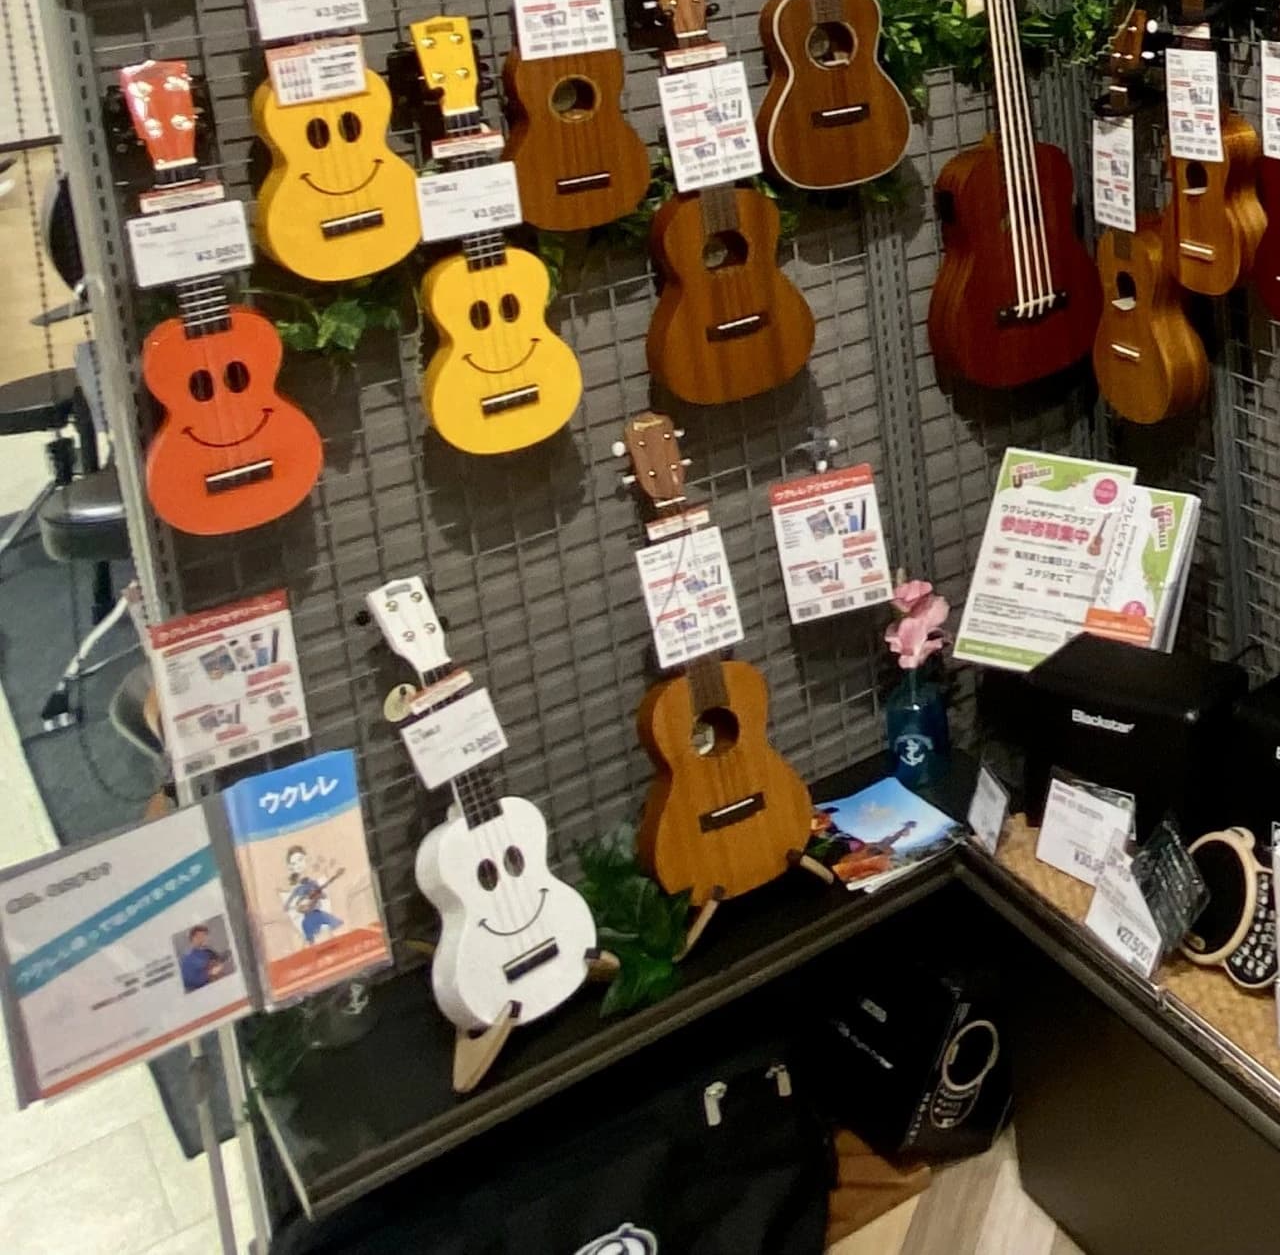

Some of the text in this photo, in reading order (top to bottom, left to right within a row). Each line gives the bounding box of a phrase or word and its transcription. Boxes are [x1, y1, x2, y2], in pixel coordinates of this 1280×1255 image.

[1072, 708, 1136, 734] Blackstar
[259, 775, 339, 815] ウクレレ
